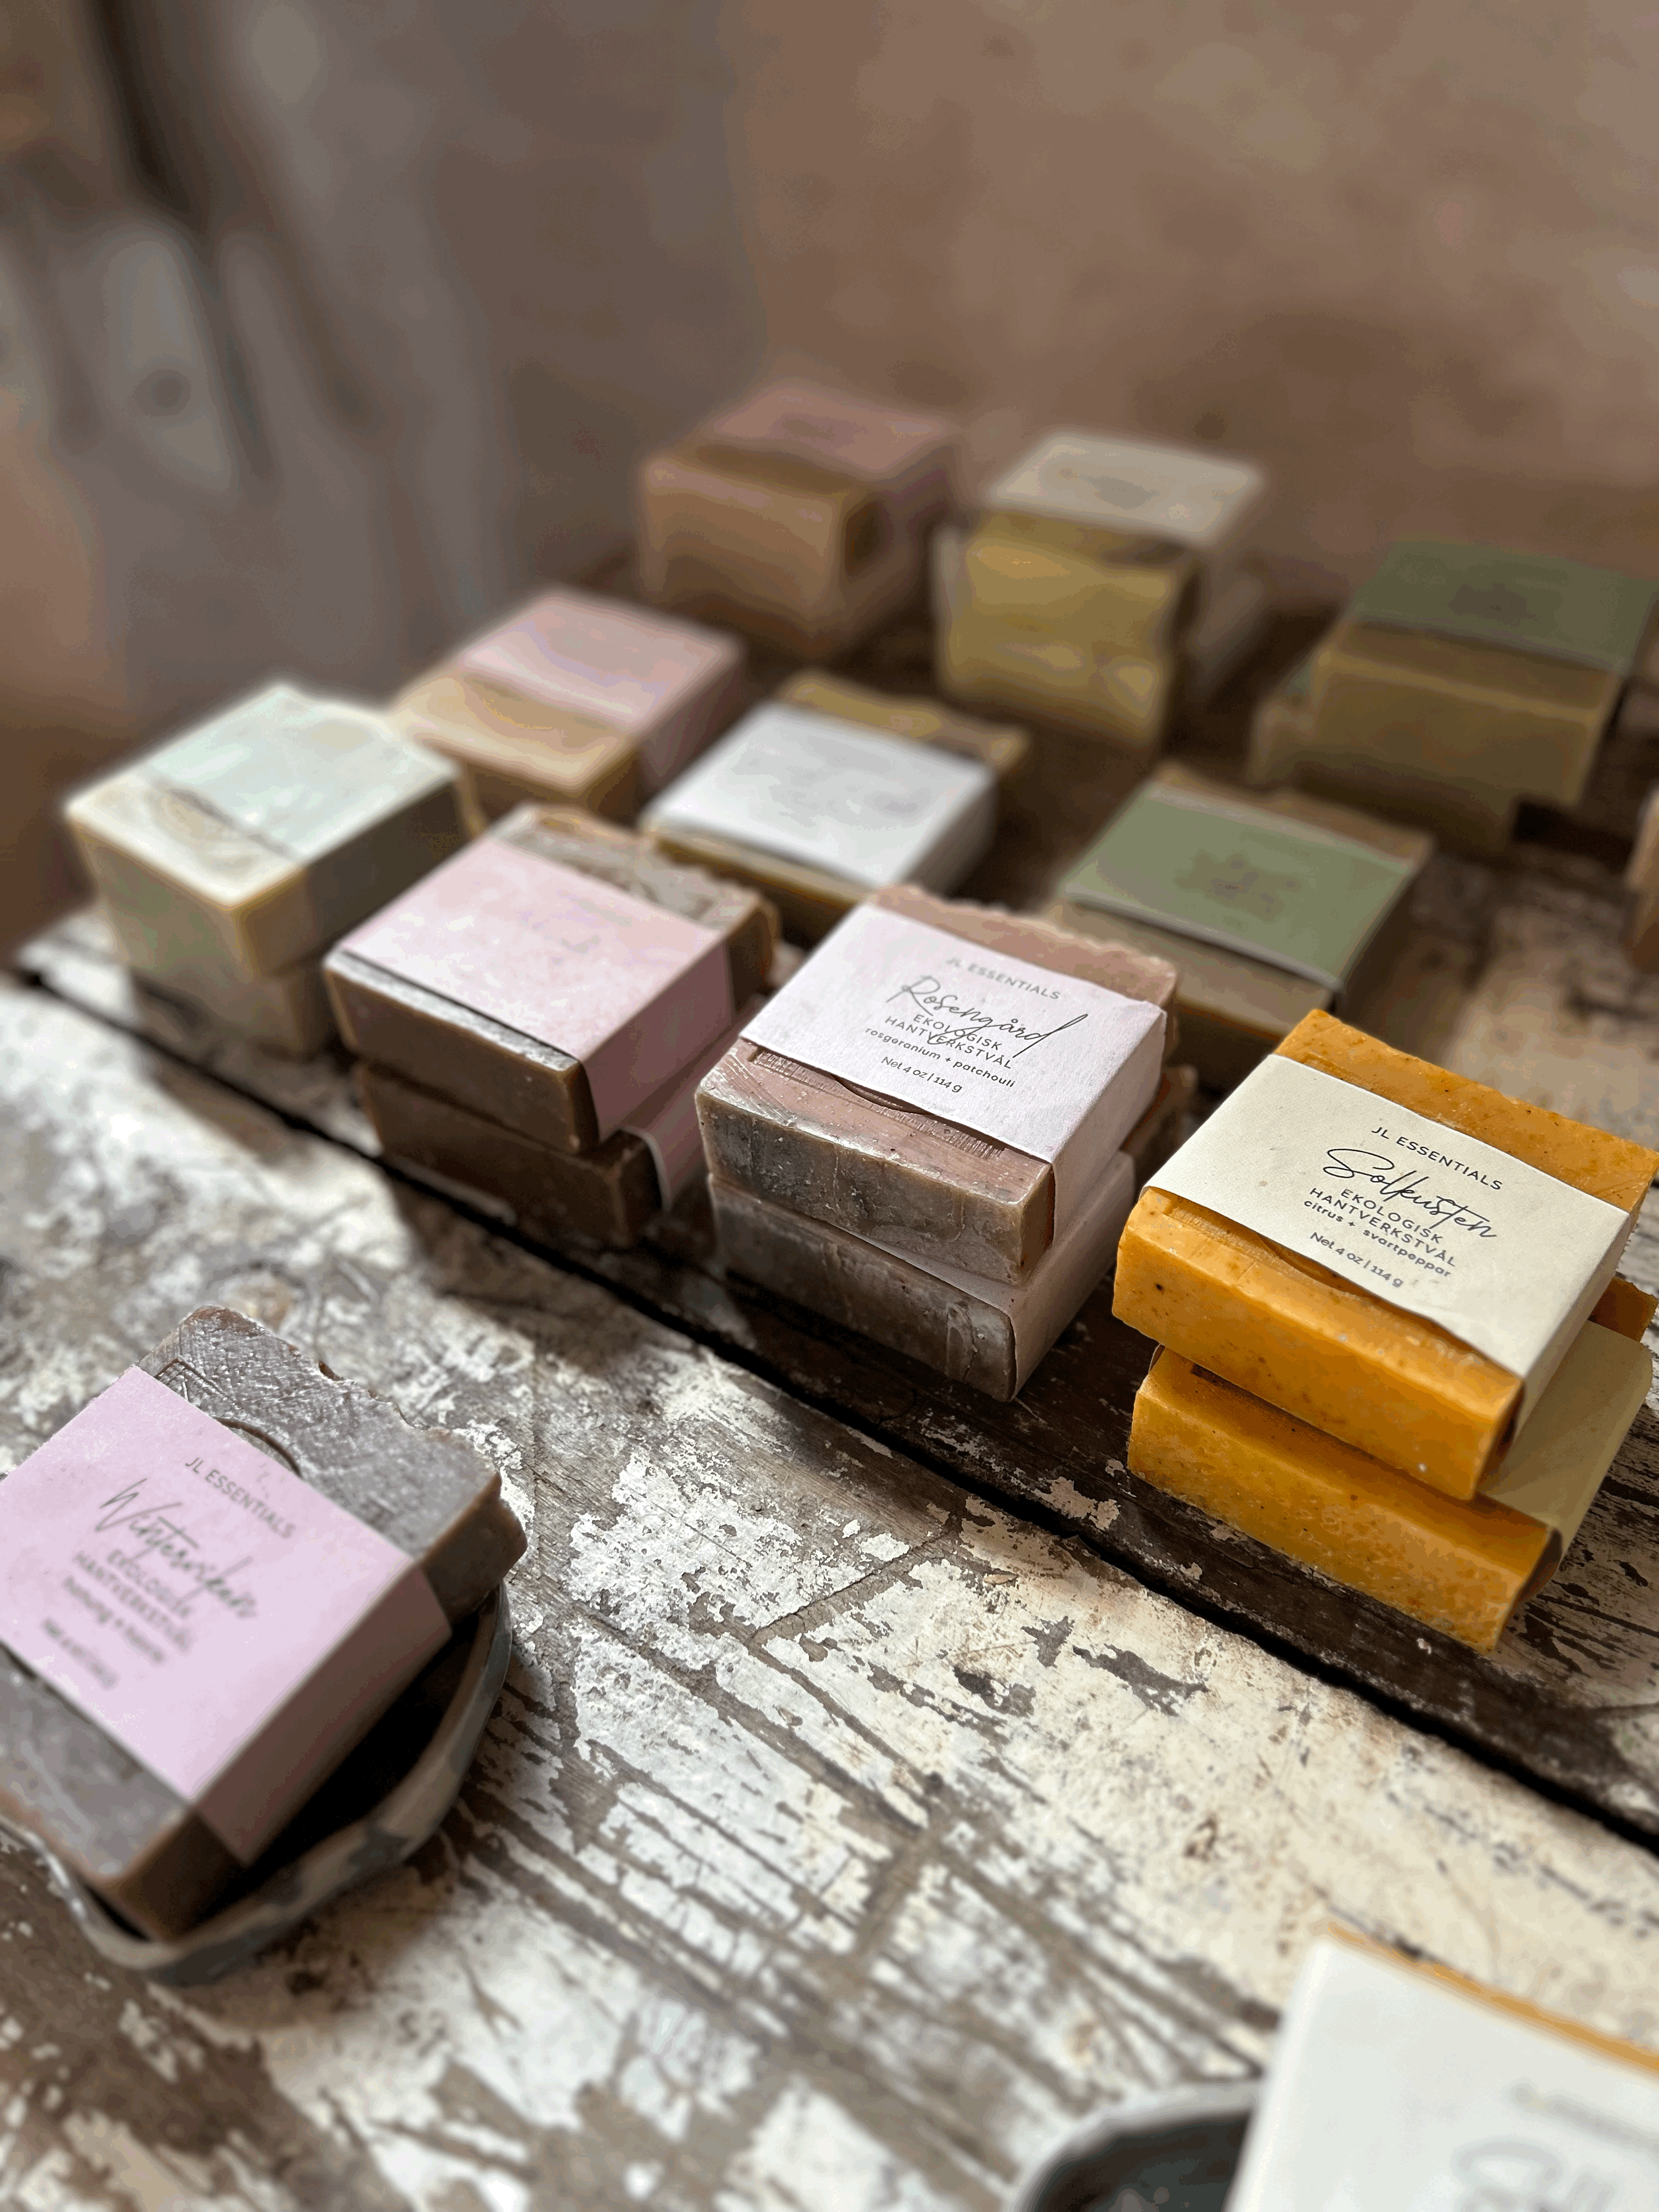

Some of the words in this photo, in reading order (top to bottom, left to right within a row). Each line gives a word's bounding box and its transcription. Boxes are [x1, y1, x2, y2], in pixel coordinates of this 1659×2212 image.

[967, 963, 1060, 1000] ESSENTIALS
[885, 1015, 1011, 1069] HANTVERKSTVÅL
[886, 975, 1089, 1058] Rosengård
[913, 1014, 1002, 1051] EKOLOGISK
[865, 1028, 941, 1060] rosgeranium
[952, 1060, 1016, 1088] patchouli
[881, 1056, 903, 1070] Net
[912, 1069, 928, 1079] oz
[933, 1076, 952, 1088] 114
[952, 1085, 962, 1093] g
[1372, 1126, 1390, 1139] JL
[1396, 1136, 1503, 1190] ESSENTIALS
[1323, 1148, 1497, 1237] Solkusten
[1340, 1188, 1443, 1244] EKOLOGISK
[1304, 1200, 1344, 1222] citrus
[1363, 1229, 1451, 1277] svartpeppar
[1310, 1188, 1455, 1267] HANTVERKSTVÅL
[1310, 1232, 1335, 1249] Net
[1346, 1252, 1364, 1265] oz
[1370, 1265, 1392, 1280] 114
[1392, 1278, 1404, 1288] g
[184, 1457, 204, 1474] JL
[204, 1468, 297, 1540] ESSENTIALS
